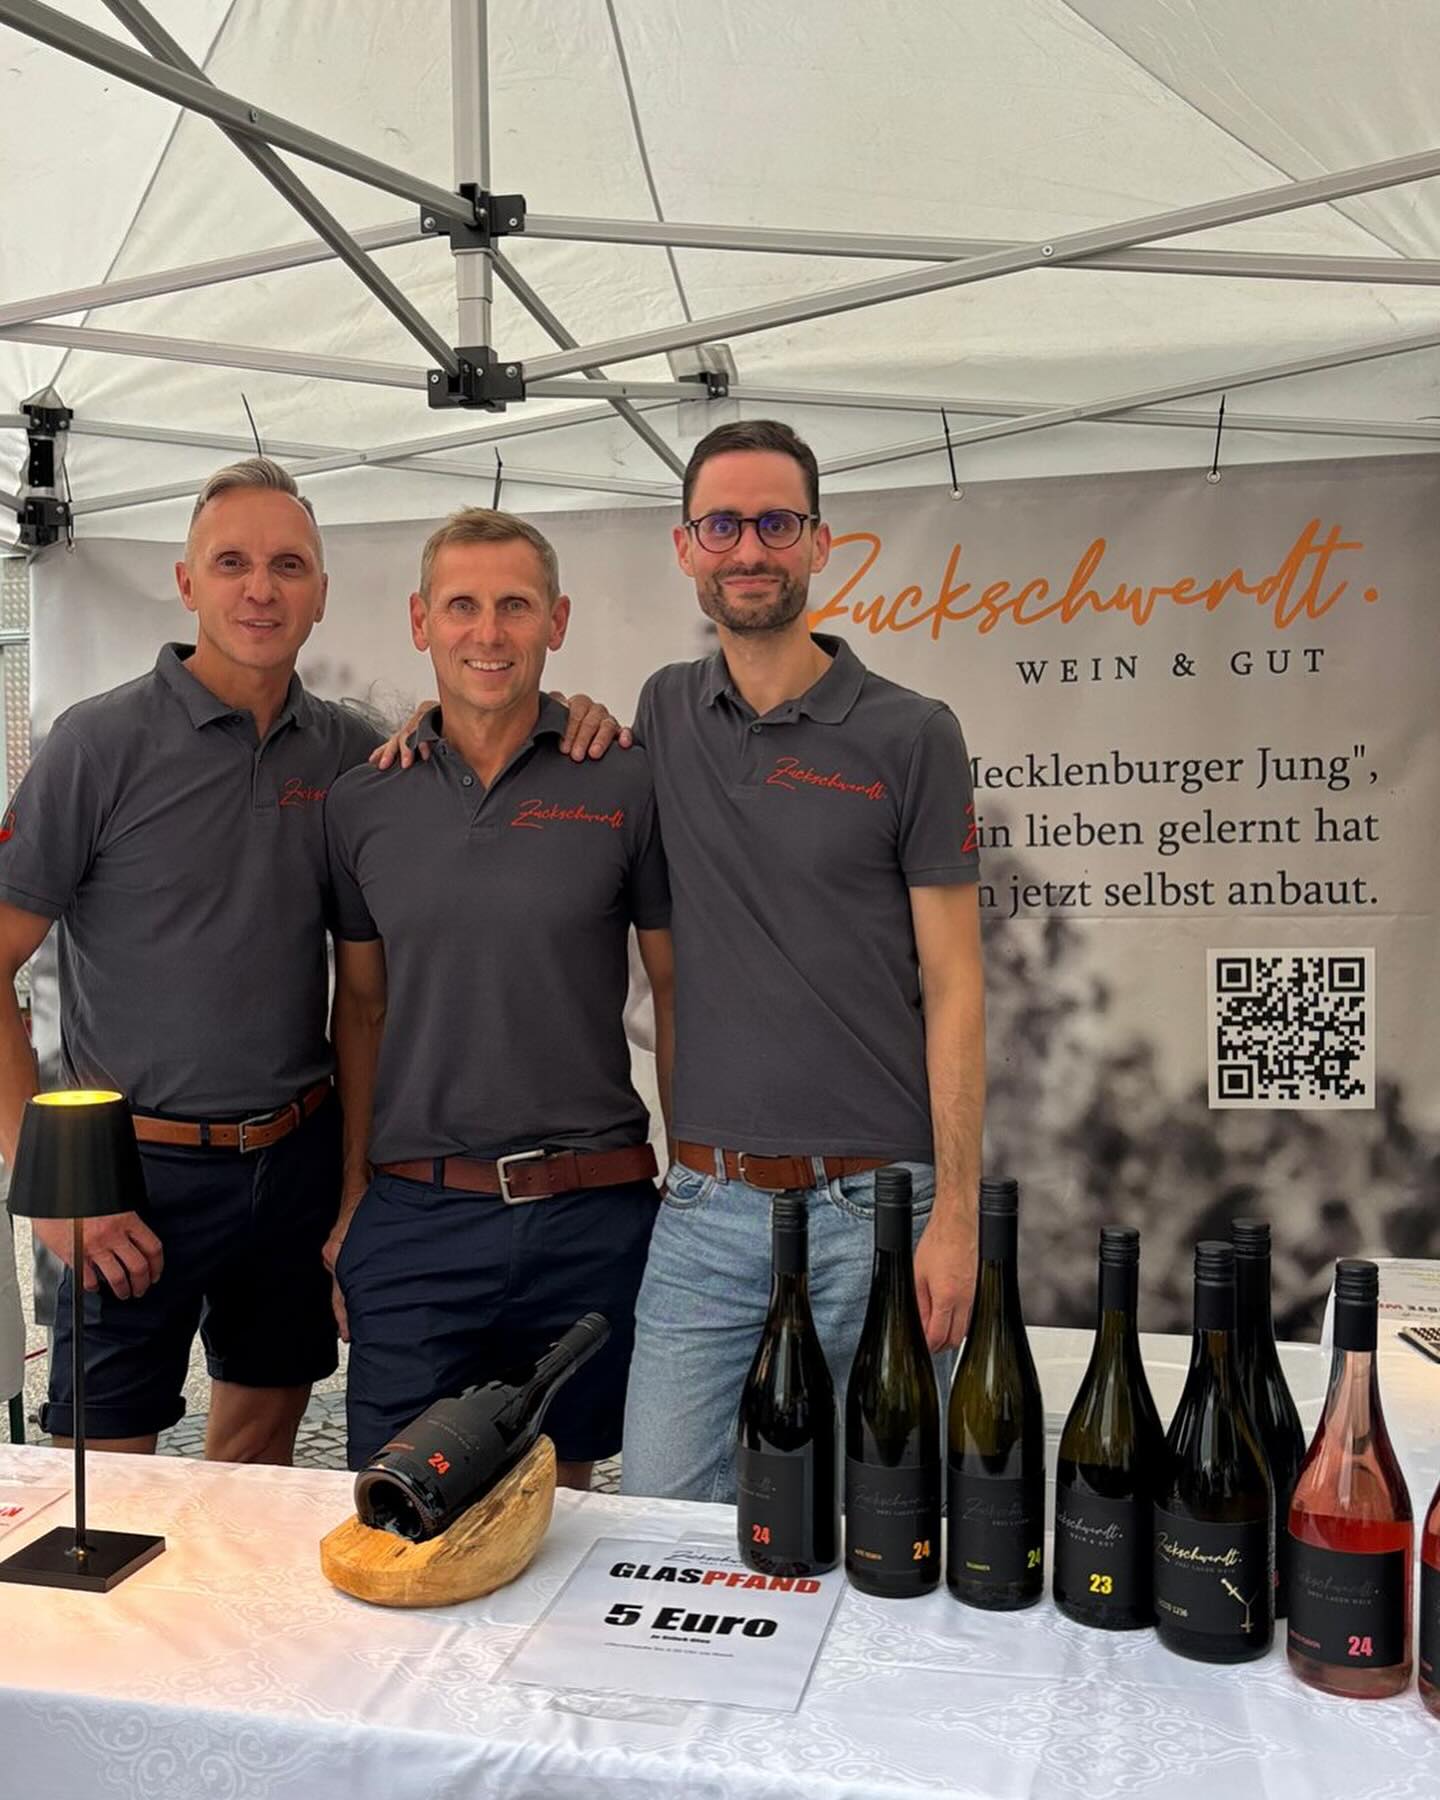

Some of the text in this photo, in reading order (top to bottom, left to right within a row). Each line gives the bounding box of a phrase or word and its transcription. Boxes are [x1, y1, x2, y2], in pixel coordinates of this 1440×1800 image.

[808, 519, 1379, 640] Zuckschwerdt.
[1017, 648, 1325, 684] WEIN & GUT
[1256, 744, 1378, 792] Jung",
[1025, 812, 1144, 848] lieben
[1158, 809, 1301, 856] gelernt
[1314, 807, 1380, 842] hat
[1009, 875, 1092, 918] jetzt
[1104, 871, 1215, 907] selbst
[1228, 870, 1378, 905] anbaut.
[427, 1451, 451, 1475] 24
[752, 1524, 771, 1545] 24
[912, 1540, 930, 1561] 24
[1027, 1548, 1041, 1569] 24
[609, 1561, 821, 1594] GLASPFAND
[1090, 1573, 1113, 1595] 23
[604, 1603, 778, 1638] 5 Euro
[1347, 1635, 1374, 1657] 24
